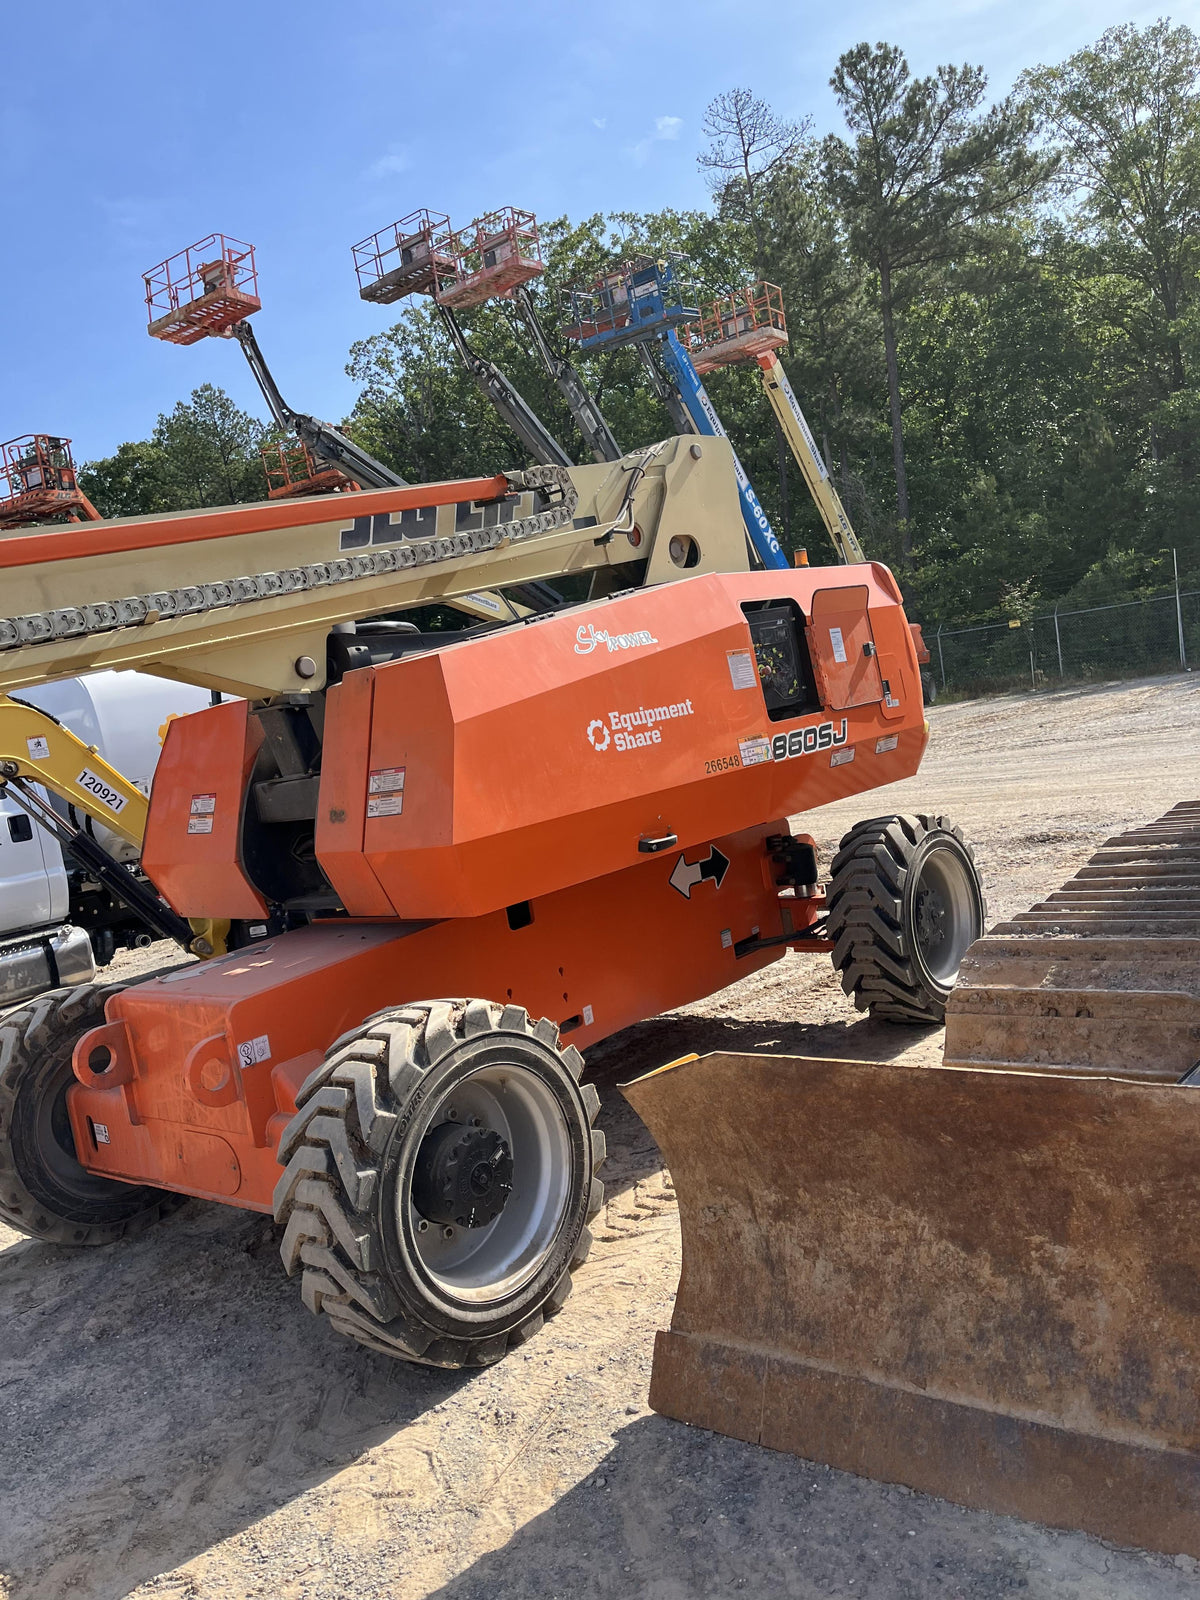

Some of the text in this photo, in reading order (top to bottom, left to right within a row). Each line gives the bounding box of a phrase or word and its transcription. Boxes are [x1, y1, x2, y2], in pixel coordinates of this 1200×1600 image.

[788, 393, 825, 474] EquipmentShare
[745, 488, 780, 555] S-60 XC
[608, 698, 694, 731] Equipment
[613, 727, 662, 752] Share
[772, 718, 848, 763] 860SJ
[704, 754, 740, 774] 266548
[78, 770, 125, 811] 120921
